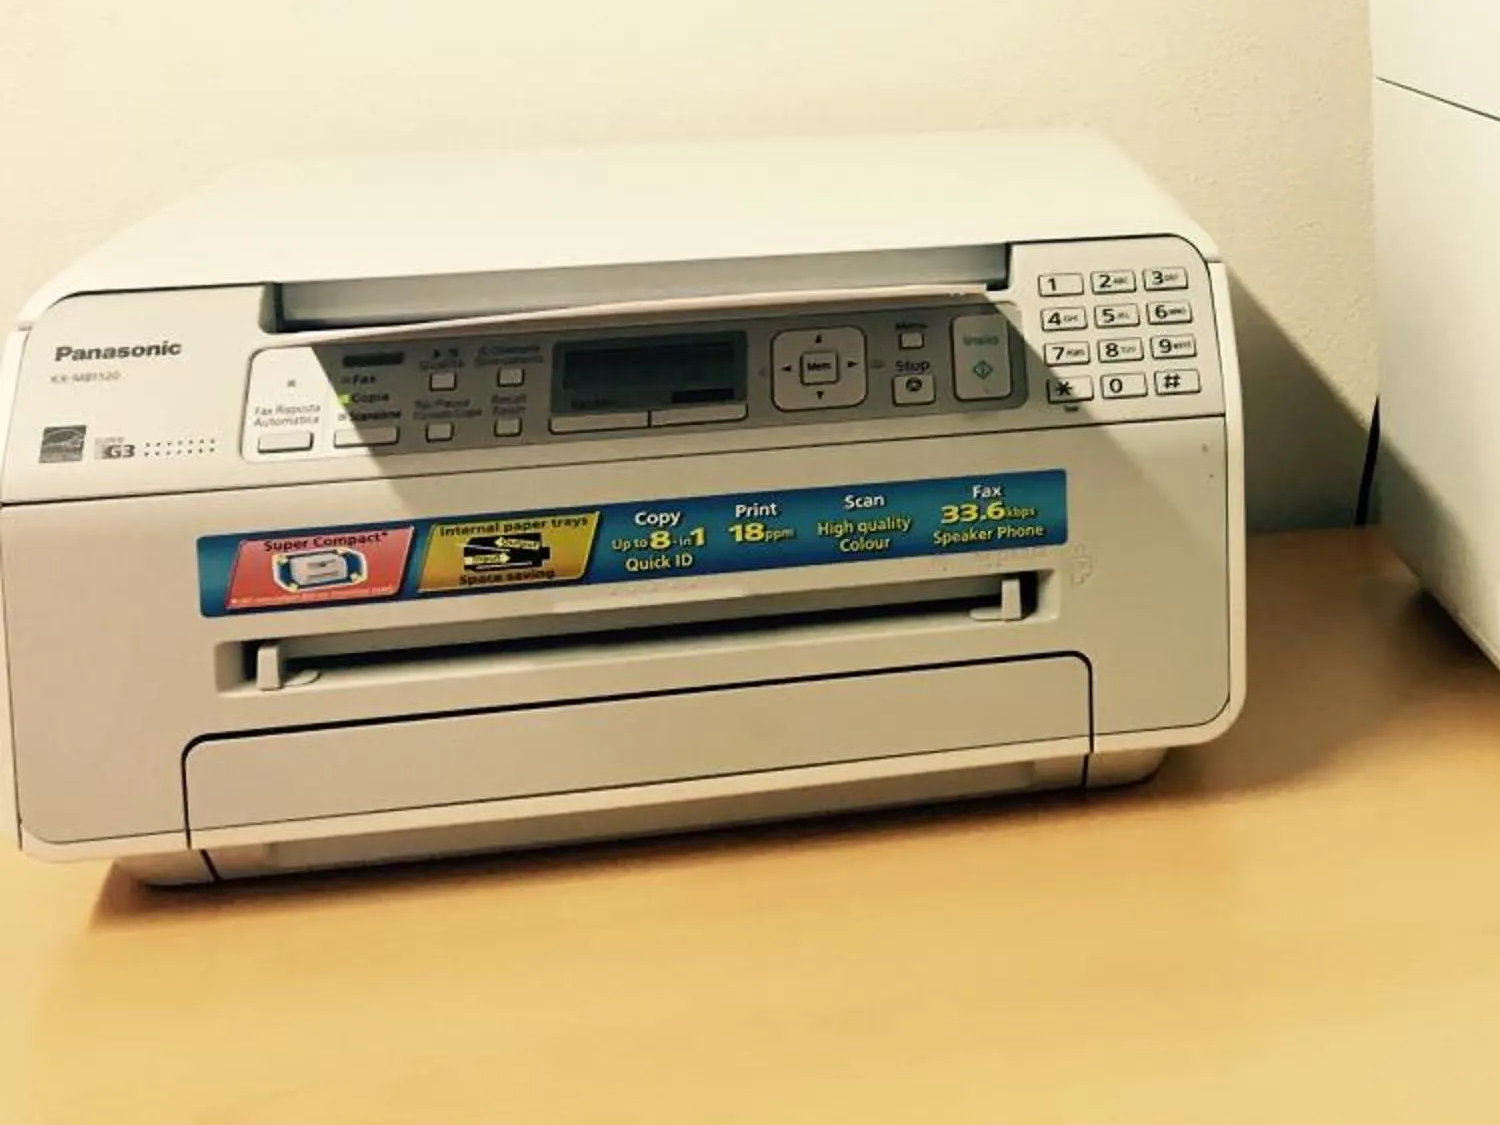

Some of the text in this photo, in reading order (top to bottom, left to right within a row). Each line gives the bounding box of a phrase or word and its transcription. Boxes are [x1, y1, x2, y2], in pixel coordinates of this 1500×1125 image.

[1047, 277, 1057, 291] 1
[1099, 274, 1112, 288] 2
[1151, 270, 1164, 285] 3
[1047, 312, 1062, 326] 4
[1102, 308, 1115, 323] 5
[1155, 305, 1168, 319] 6
[54, 340, 183, 362] Panasonic
[1051, 346, 1065, 360] 7
[1105, 342, 1119, 357] 8
[1158, 338, 1172, 354] 9
[895, 359, 931, 373] Stop
[1109, 378, 1123, 393] 0
[104, 444, 136, 460] G3
[972, 485, 1002, 500] Fax
[844, 494, 885, 510] Scan
[635, 510, 682, 526] Copy
[735, 502, 778, 519] Print
[439, 516, 589, 537] Internal paper trays
[817, 515, 912, 536] High quality
[933, 524, 1044, 546] Speaker Phone
[264, 538, 309, 553] Super
[611, 539, 631, 551] Up
[634, 537, 648, 549] to
[839, 537, 891, 553] Colour
[625, 554, 693, 572] Quick ID
[459, 569, 556, 586] Space saving
